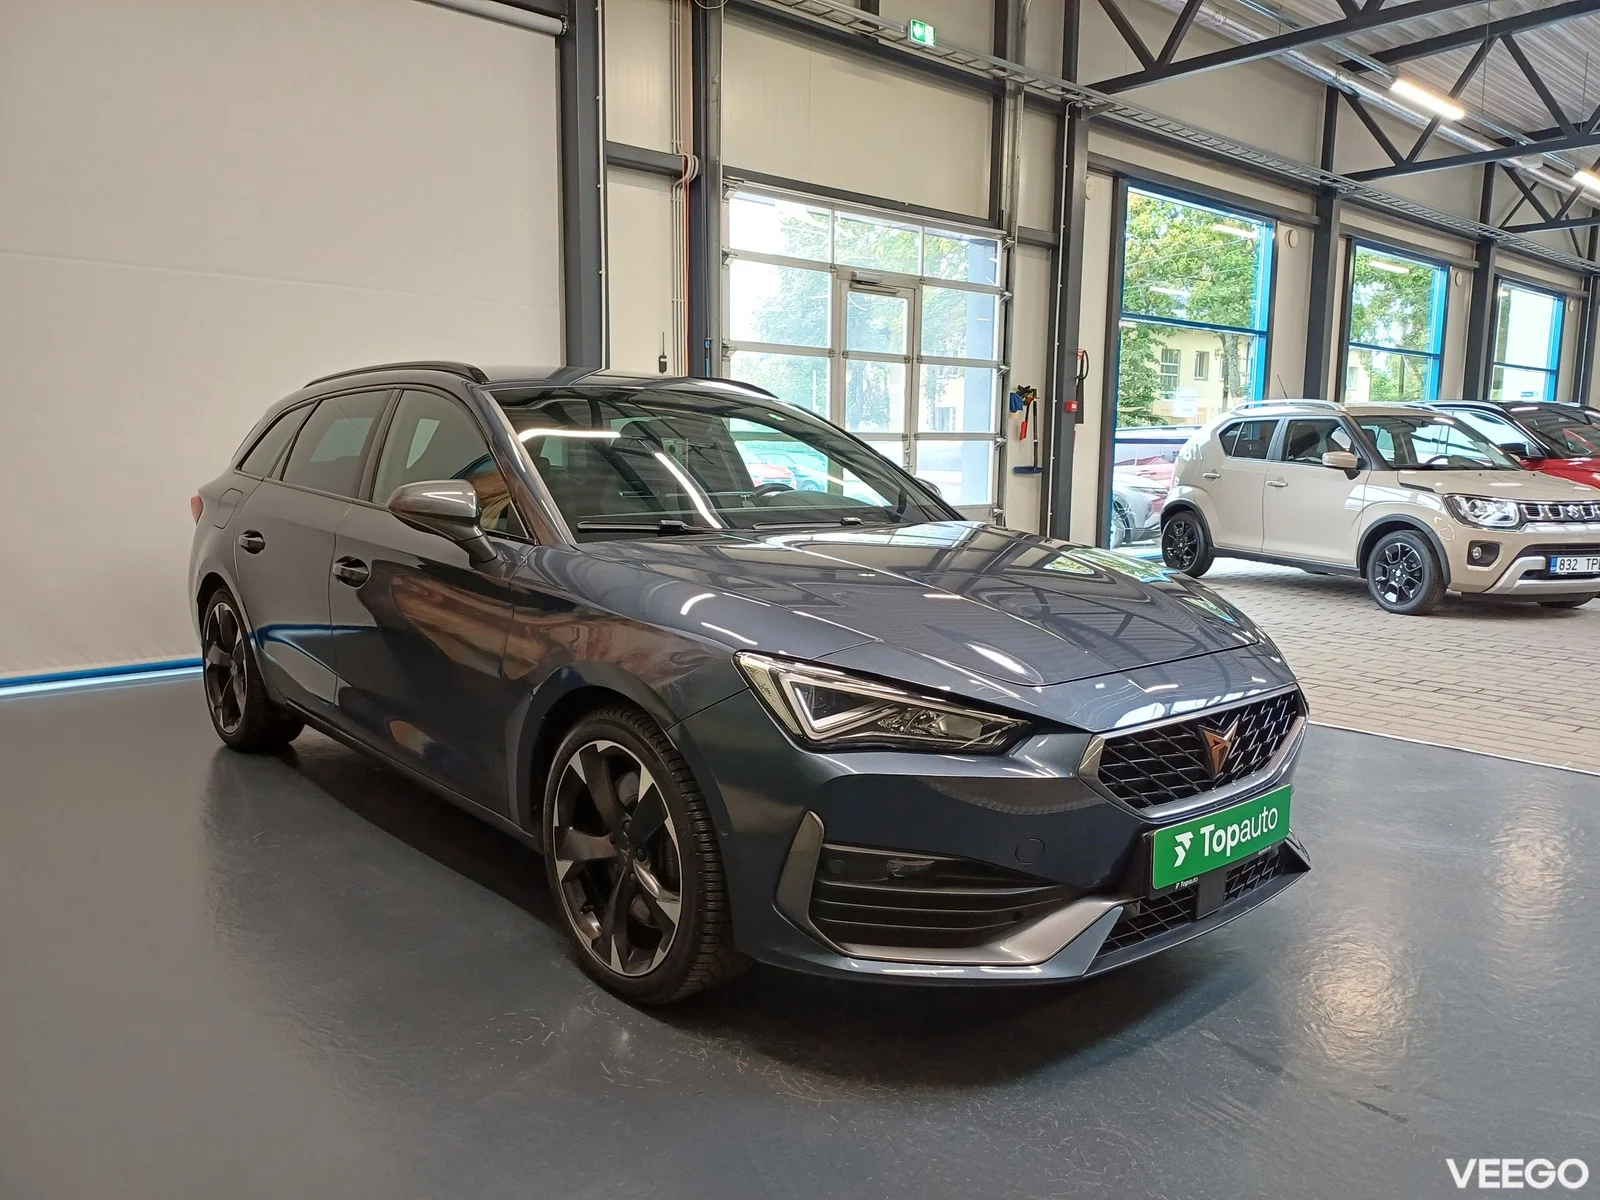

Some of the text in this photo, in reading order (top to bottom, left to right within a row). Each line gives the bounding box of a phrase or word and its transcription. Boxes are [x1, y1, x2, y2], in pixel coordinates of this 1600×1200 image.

[1559, 558, 1578, 571] 832
[1200, 806, 1278, 857] Topauto
[1180, 877, 1199, 888] Topauto
